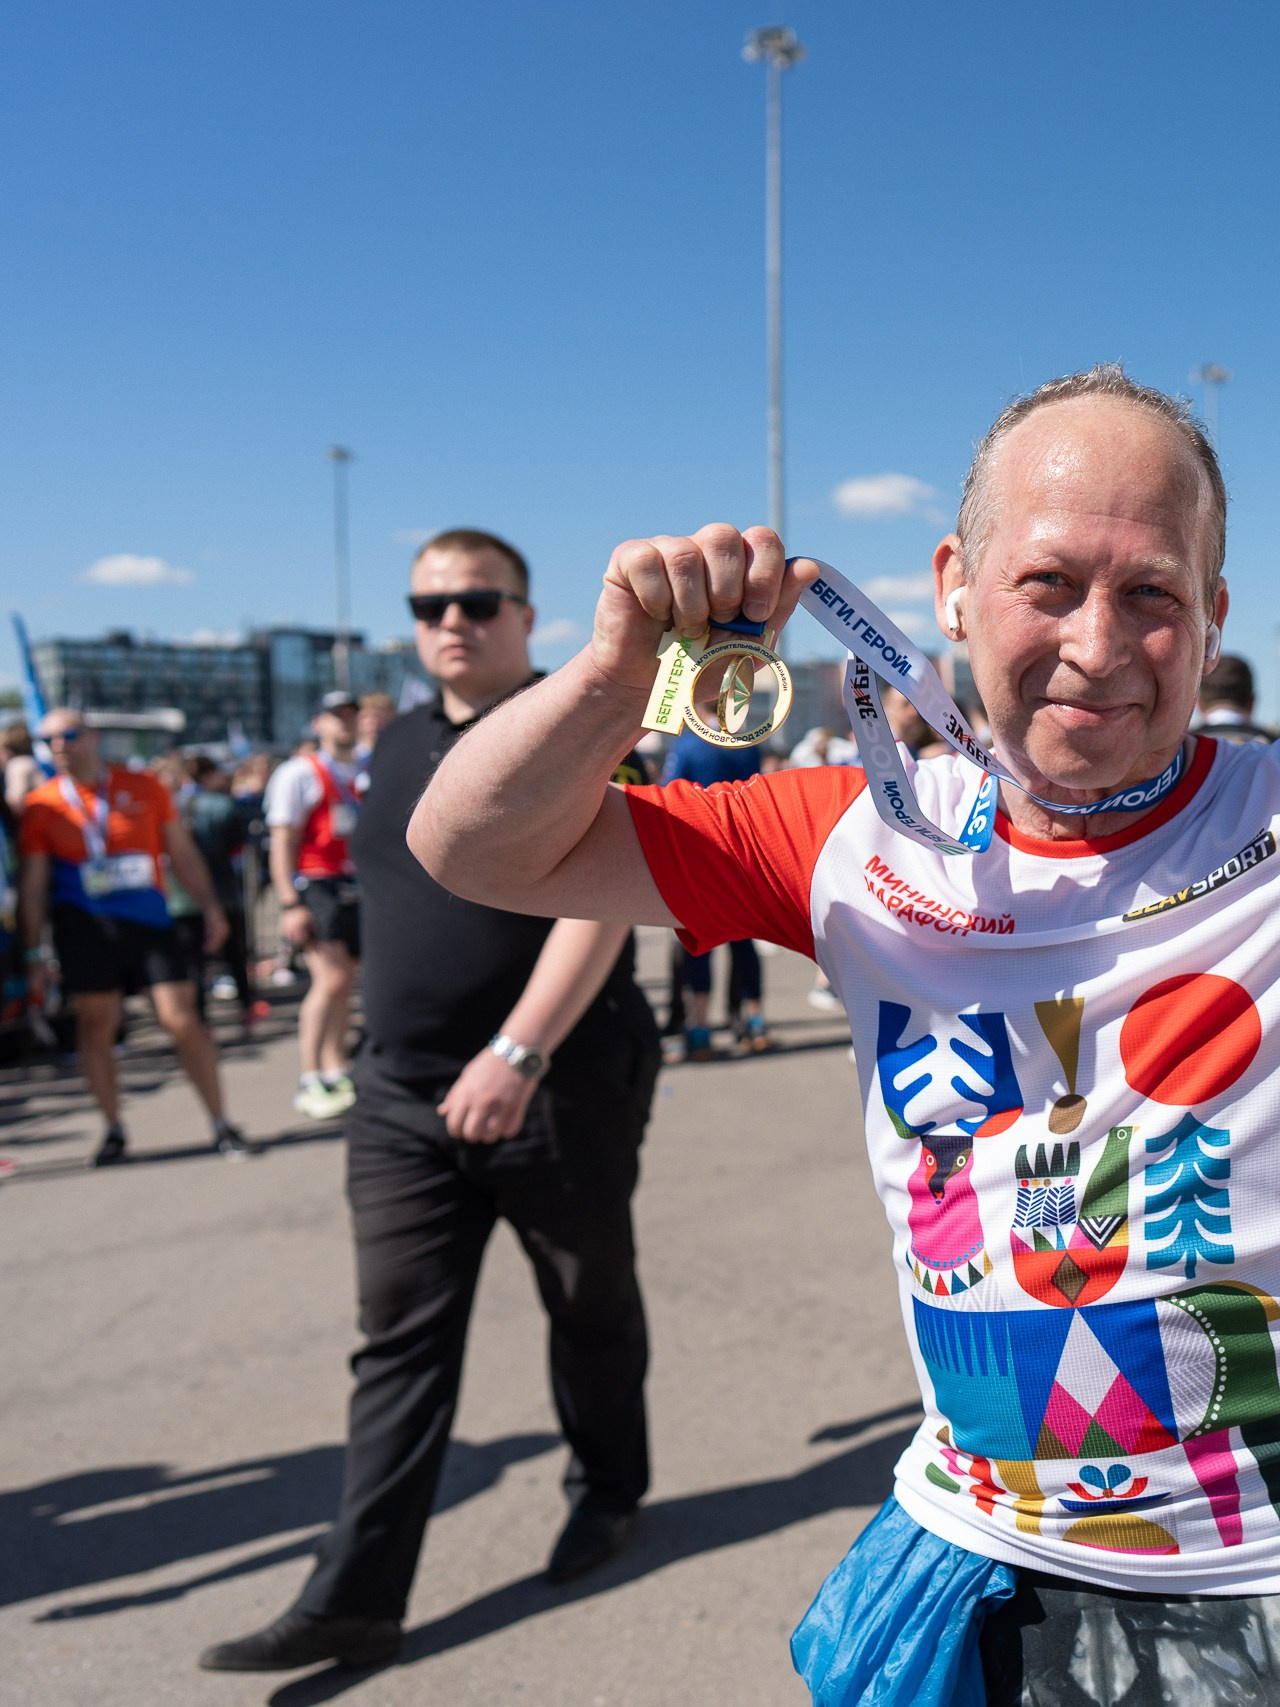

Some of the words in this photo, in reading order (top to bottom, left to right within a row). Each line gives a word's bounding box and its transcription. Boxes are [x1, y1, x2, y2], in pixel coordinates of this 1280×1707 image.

[810, 578, 856, 627] БЕГИ,
[851, 617, 912, 677] ГЕРОЙ!
[684, 705, 710, 736] НИЖНИЙ
[708, 731, 756, 744] НОВГОРОД
[755, 722, 773, 738] 2024
[865, 854, 1016, 935] МИНИНСКИЙ
